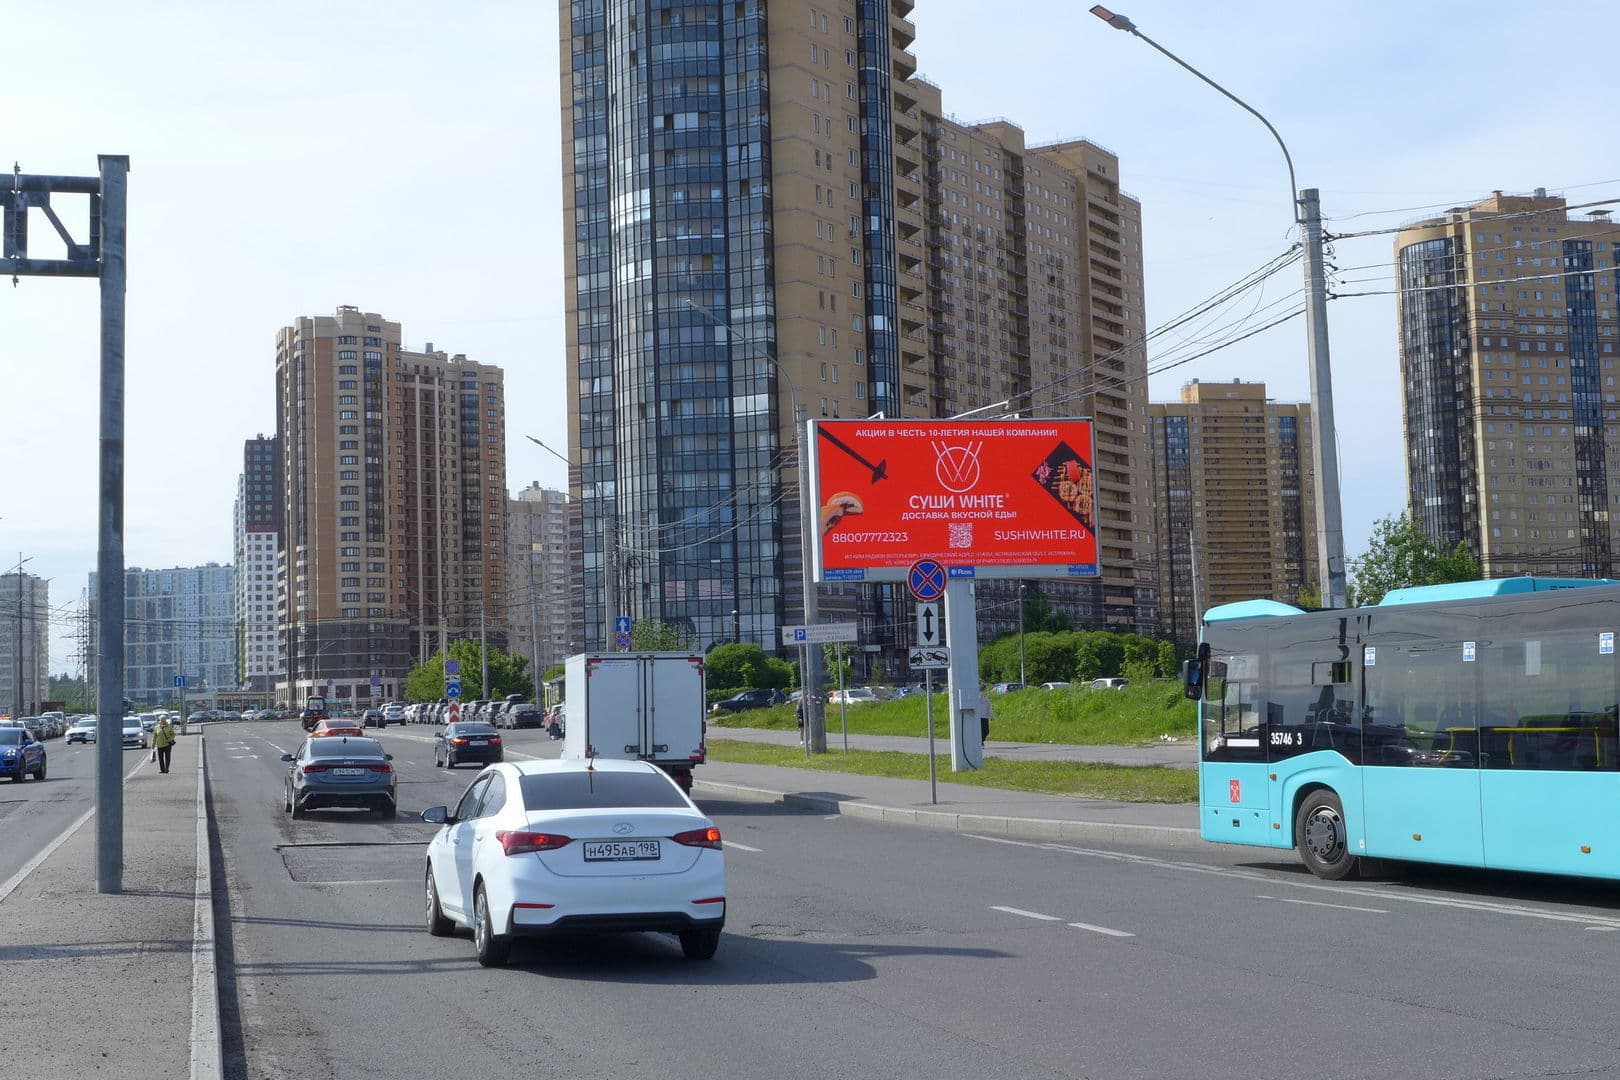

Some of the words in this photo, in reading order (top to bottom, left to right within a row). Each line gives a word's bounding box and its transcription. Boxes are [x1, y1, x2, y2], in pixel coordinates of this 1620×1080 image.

[855, 429, 886, 437] АКЦИИ
[896, 429, 926, 437] ЧЕСТЬ
[928, 429, 970, 437] 10-ЛЕТИЯ
[971, 428, 1005, 436] НАШЕЙ
[1006, 428, 1058, 436] КОМПАНИИ!
[909, 495, 955, 509] СУШИ
[959, 494, 1004, 508] WHITE
[901, 511, 949, 520] ДОСТАВКА
[951, 510, 993, 519] ВКУСНОЙ
[995, 510, 1017, 518] ЕДЫ!
[832, 532, 908, 543] 88007772323
[994, 529, 1086, 540] SUSHIWHITE.RU
[1271, 732, 1292, 745] 35746
[1297, 732, 1302, 745] 3
[638, 843, 655, 852] 198
